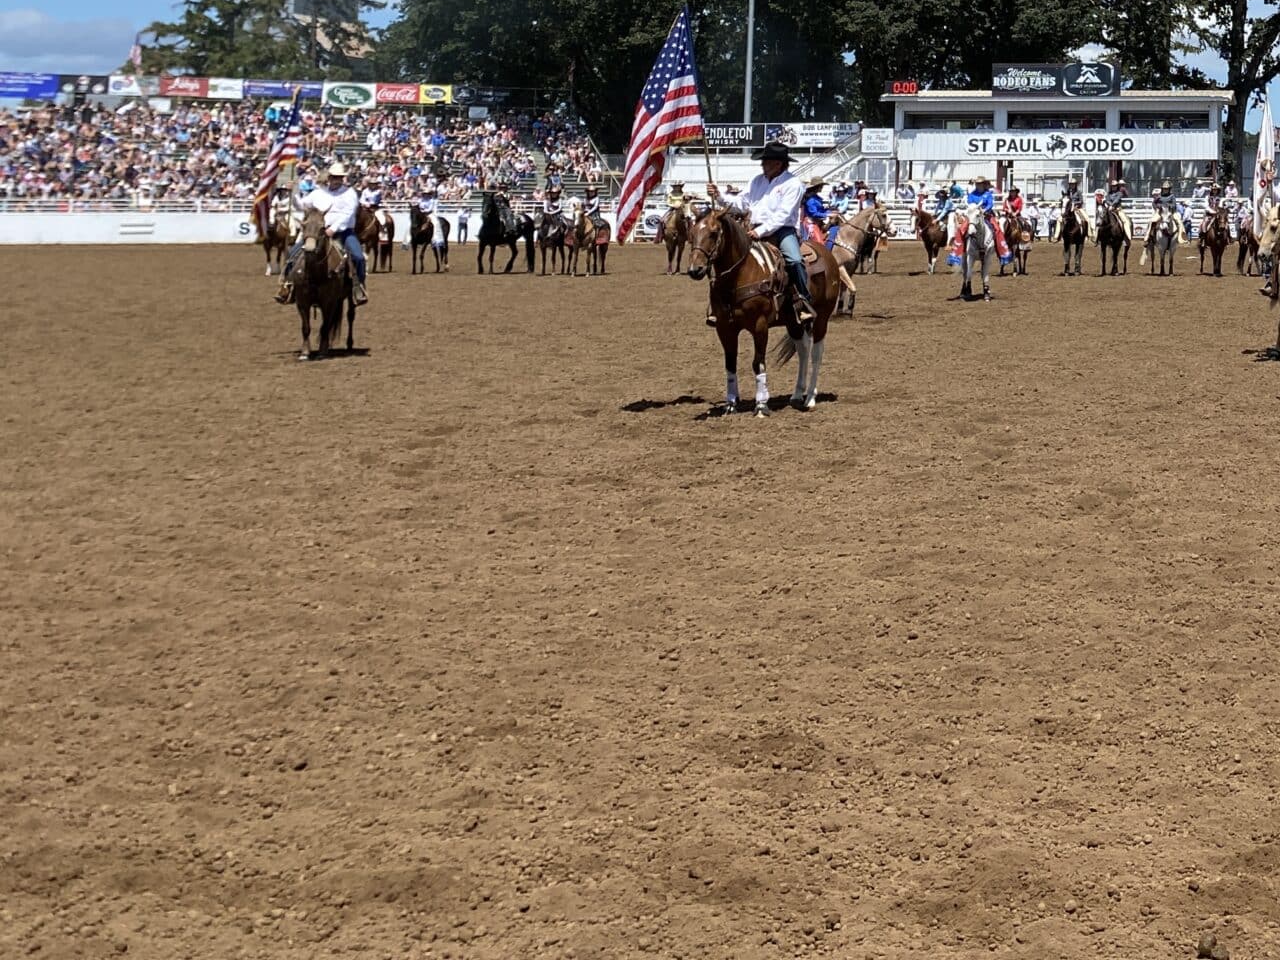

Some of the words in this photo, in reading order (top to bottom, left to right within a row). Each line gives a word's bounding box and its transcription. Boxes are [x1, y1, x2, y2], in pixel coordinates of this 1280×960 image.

[1007, 68, 1042, 77] Welcome
[993, 77, 1028, 87] RODEO
[1029, 77, 1056, 87] FANS
[704, 126, 753, 140] ENDLETON
[968, 138, 990, 153] ST
[996, 138, 1042, 153] PAUL
[1071, 138, 1134, 153] RODEO
